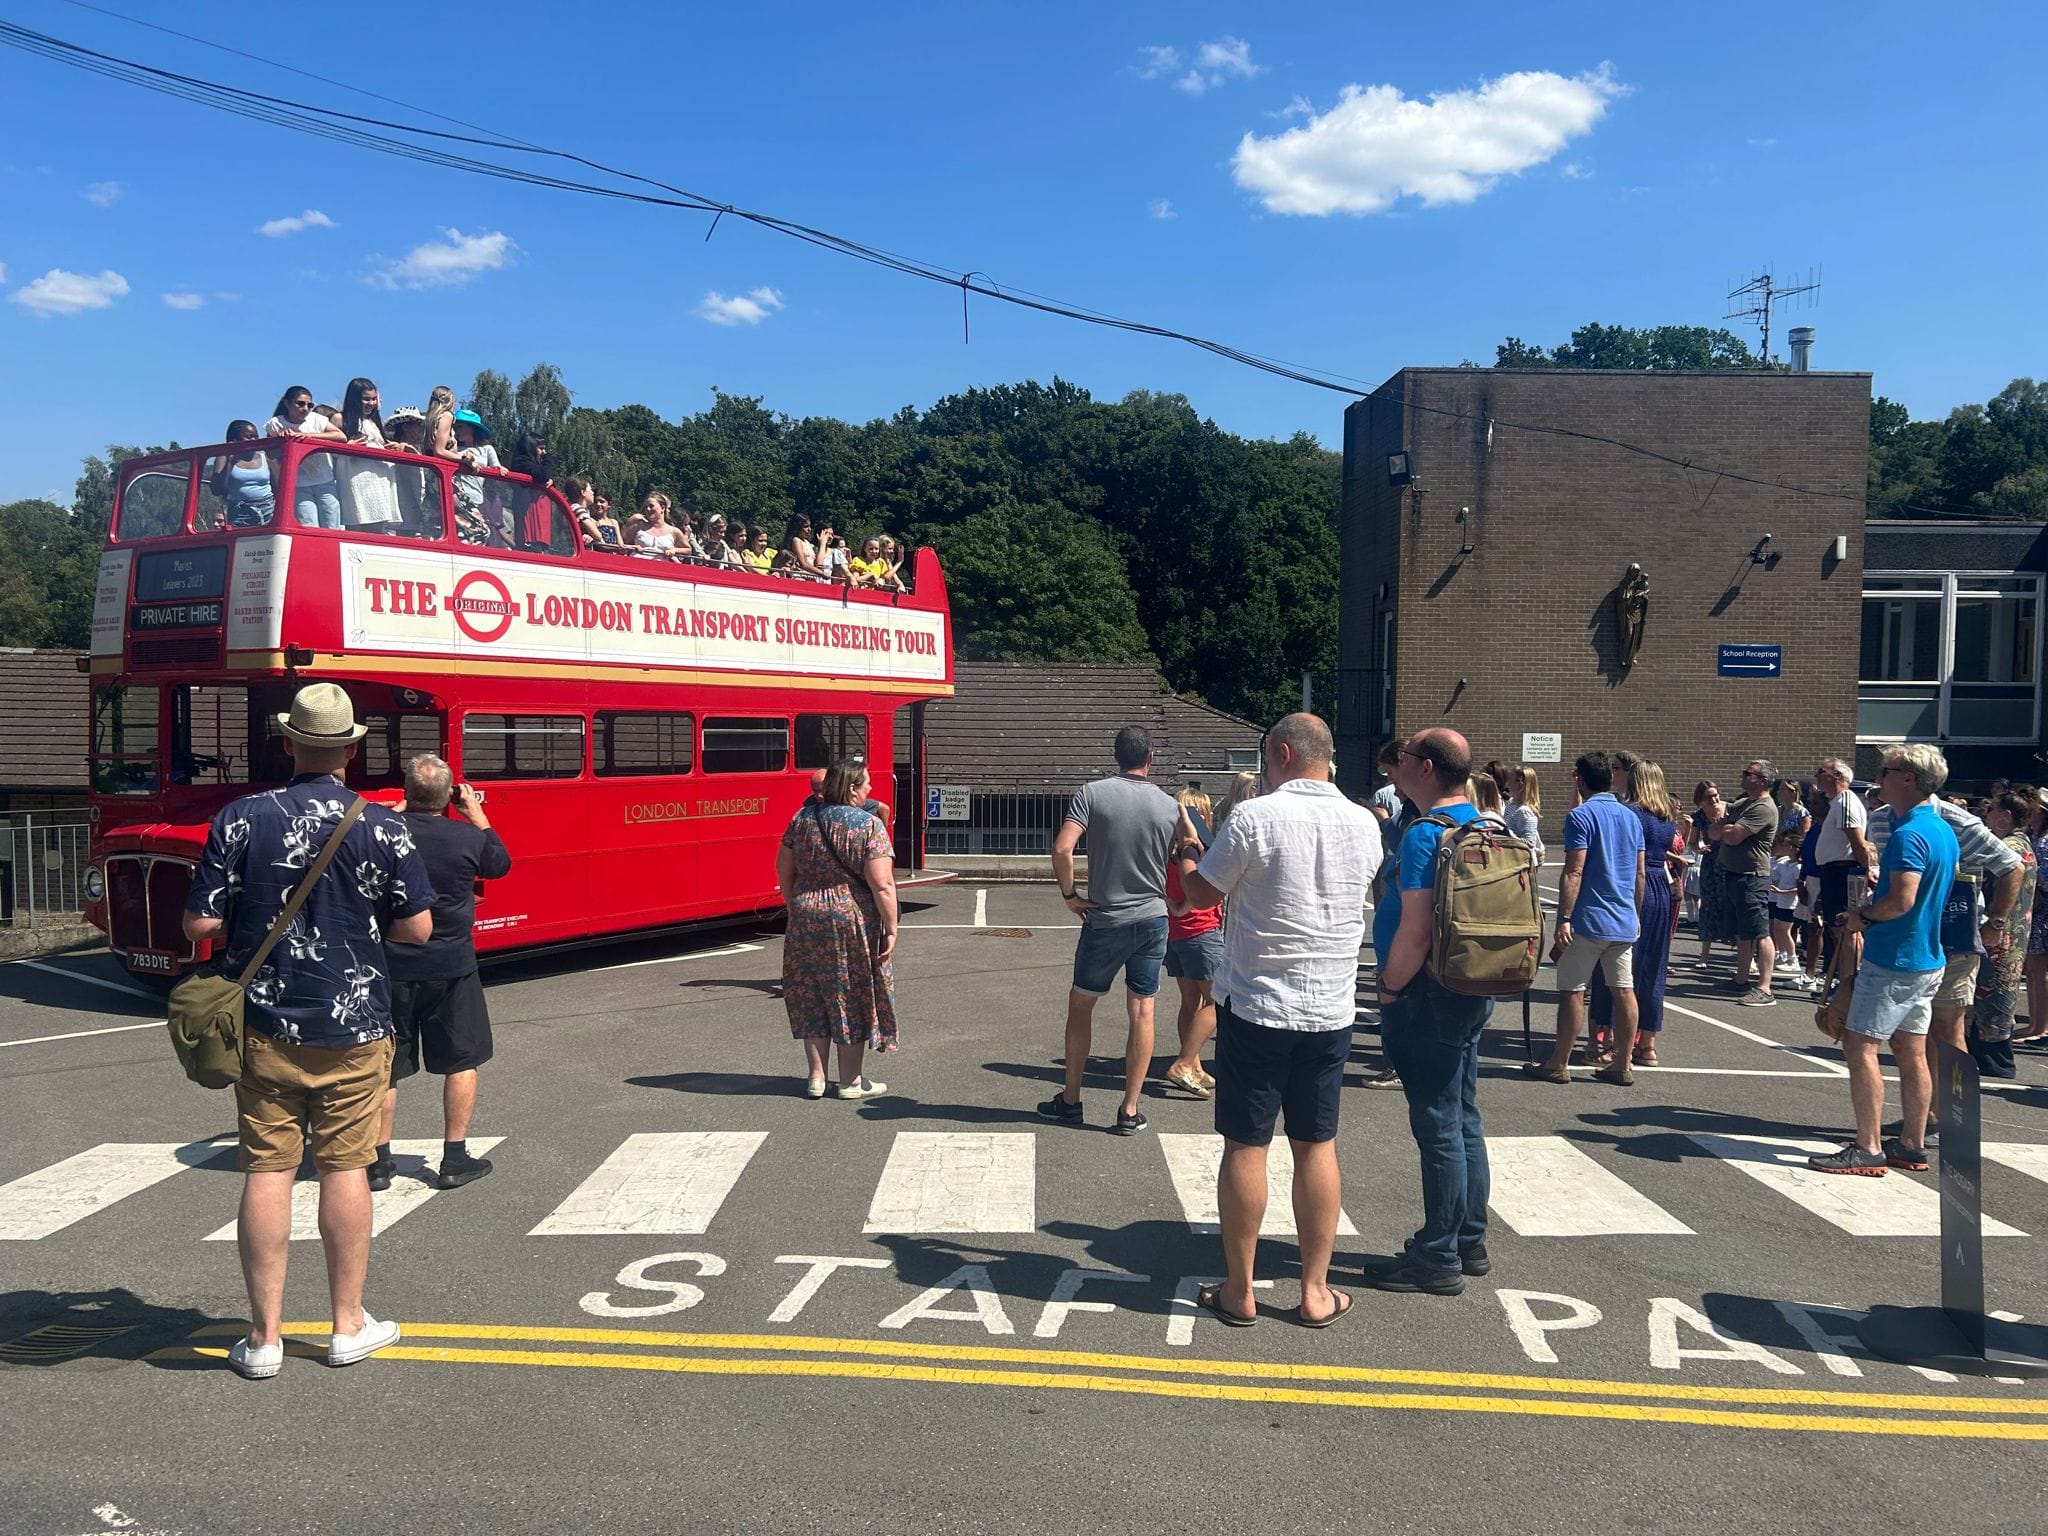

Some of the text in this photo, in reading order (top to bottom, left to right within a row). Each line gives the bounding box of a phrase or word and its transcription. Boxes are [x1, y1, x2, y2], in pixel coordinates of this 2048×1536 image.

[141, 606, 186, 624] PRIVATE
[190, 604, 218, 622] HIRE
[453, 597, 513, 615] ORIGINAL
[365, 577, 937, 656] THE LONDON TRANSPORT SIGHTSEEING TOUR
[1745, 650, 1778, 658] Reception
[929, 789, 939, 802] P
[624, 797, 769, 824] LONDON TRANSPORT
[579, 1252, 1274, 1346] STAFF
